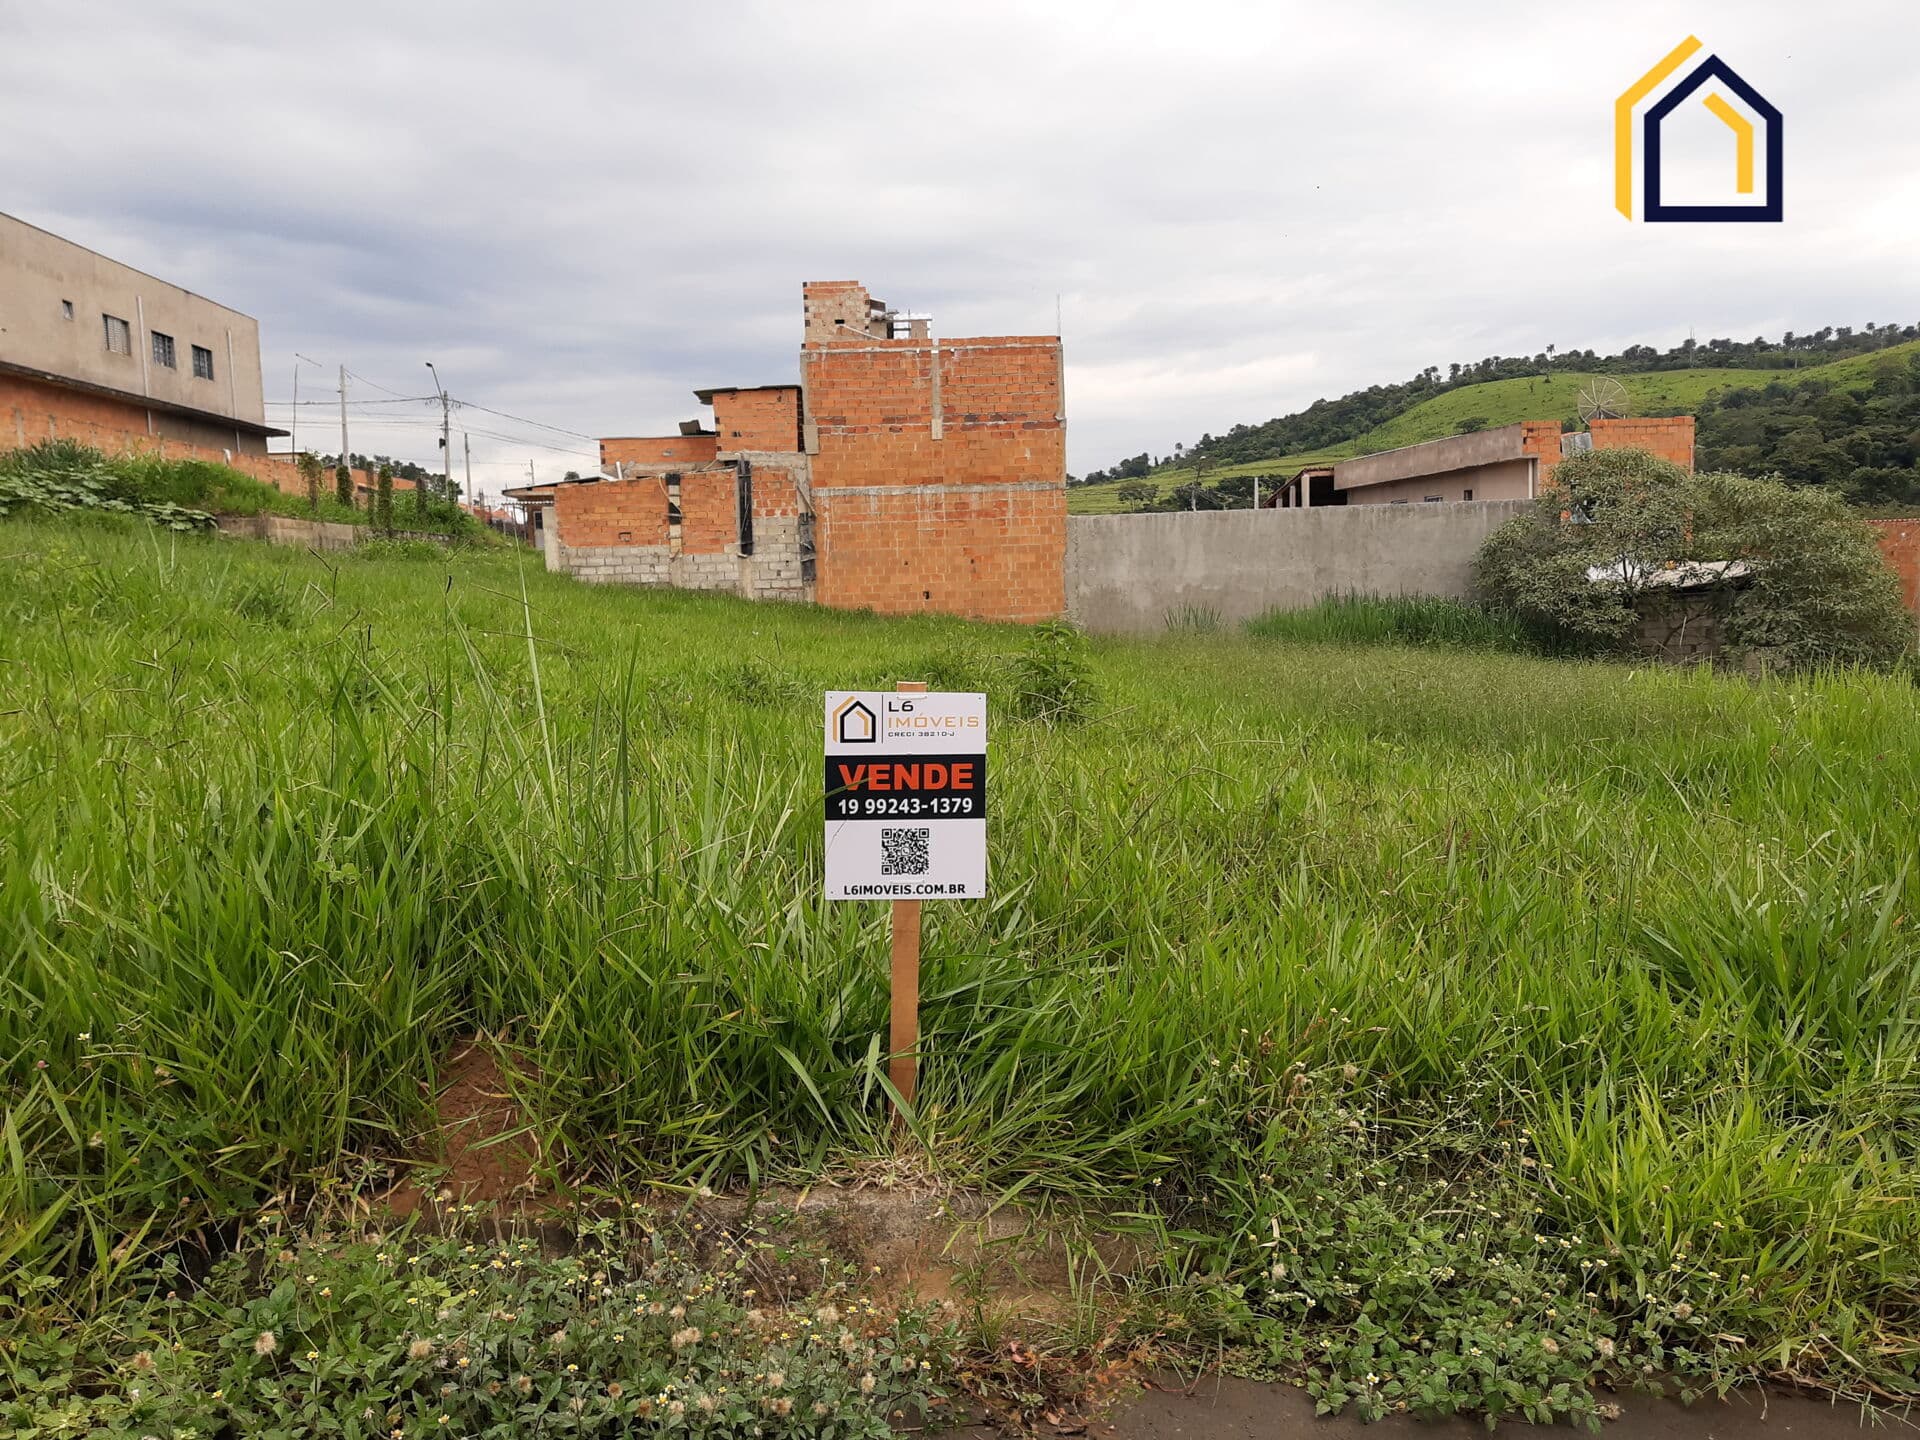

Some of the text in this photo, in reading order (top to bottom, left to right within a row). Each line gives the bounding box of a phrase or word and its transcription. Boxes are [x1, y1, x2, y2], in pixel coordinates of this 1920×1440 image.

[888, 701, 914, 712] L6
[888, 713, 979, 728] IMÓVEIS
[838, 763, 974, 791] VENDE
[838, 798, 973, 814] 19 99243-1379
[843, 884, 966, 896] L6IMOVEIS.COM.BR
